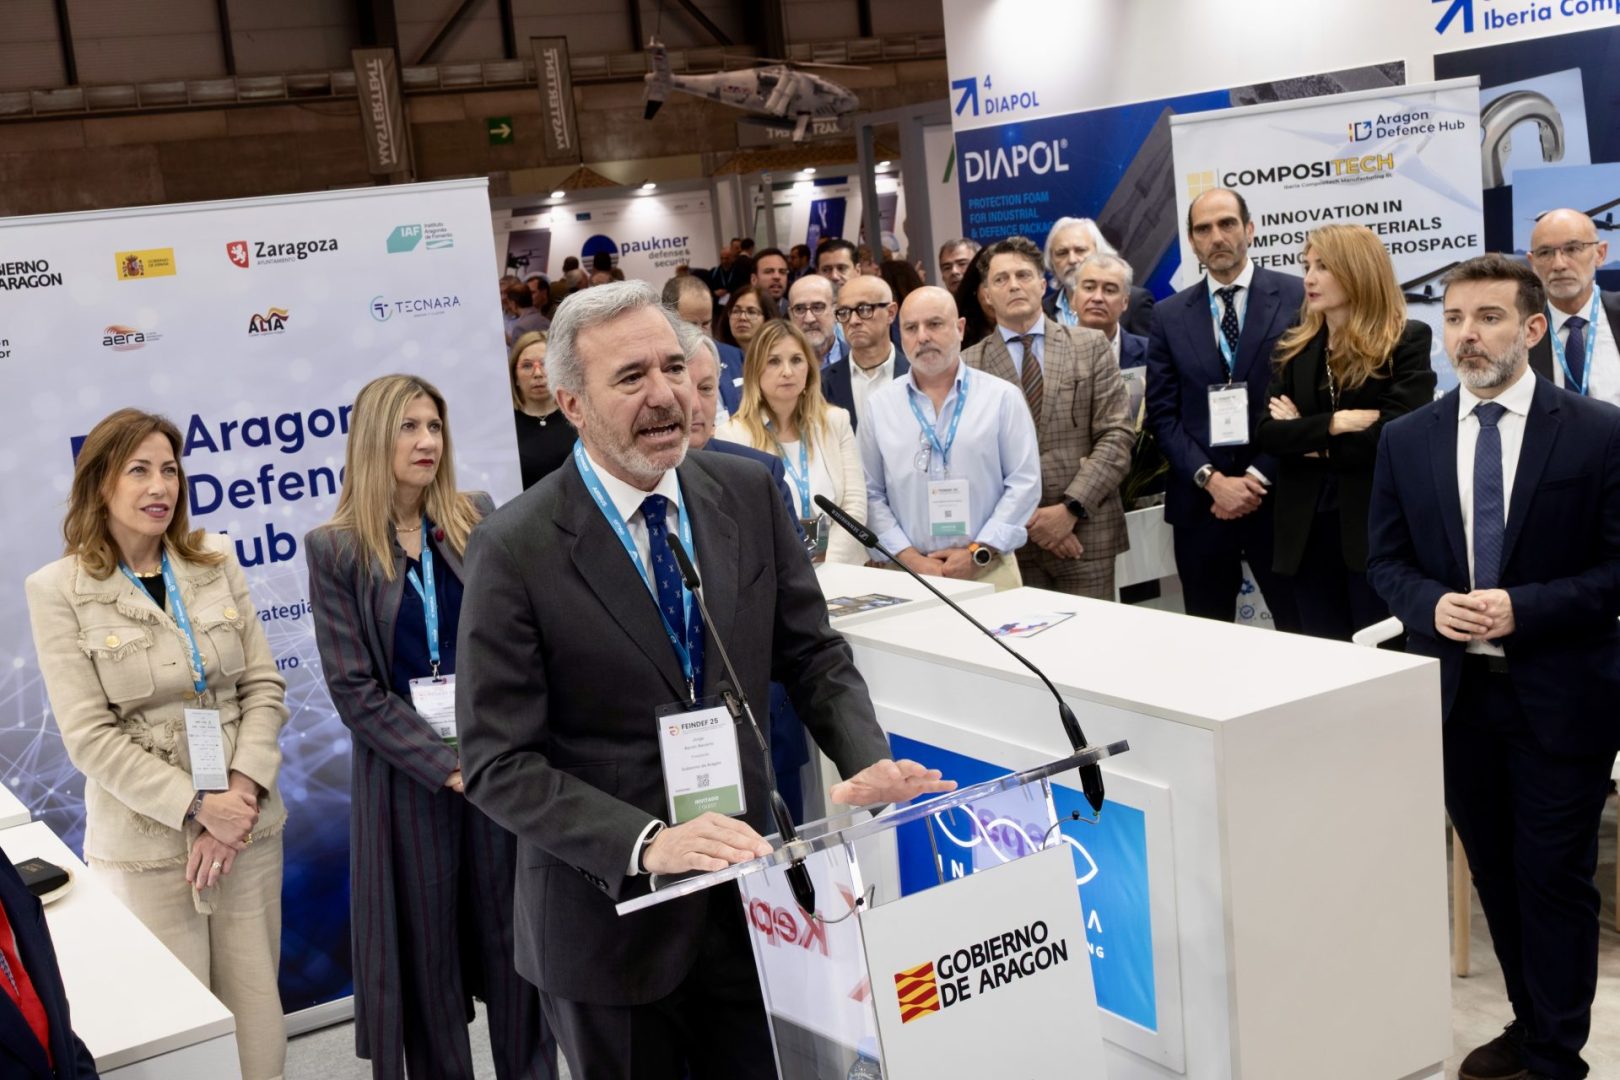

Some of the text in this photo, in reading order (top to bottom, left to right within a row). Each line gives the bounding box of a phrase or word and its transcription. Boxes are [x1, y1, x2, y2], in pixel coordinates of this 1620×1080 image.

[1484, 3, 1551, 30] Iberia
[983, 74, 992, 90] 4
[985, 91, 1039, 114] DIAPOL
[1376, 111, 1429, 125] Aragon
[1376, 119, 1465, 139] Defence Hub
[1222, 153, 1394, 188] COMPOSITECH
[969, 191, 1049, 209] PROTECTION FOAM
[970, 208, 1039, 225] FOR INDUSTRIAL
[1261, 200, 1402, 227] INNOVATION IN
[401, 226, 420, 237] IAF
[980, 224, 1018, 238] DEFENCE
[254, 238, 338, 260] Zaragoza
[621, 236, 689, 256] paukner
[649, 248, 684, 260] defense
[0, 259, 49, 276] IERNO
[394, 295, 461, 313] TECNARA
[102, 332, 145, 347] aera
[187, 463, 346, 516] Defen
[218, 523, 297, 568] ub
[681, 719, 709, 730] FEINDEF
[709, 717, 719, 725] 25
[937, 920, 1048, 980] GOBIERNO
[940, 938, 1068, 1008] DE ARAGON
